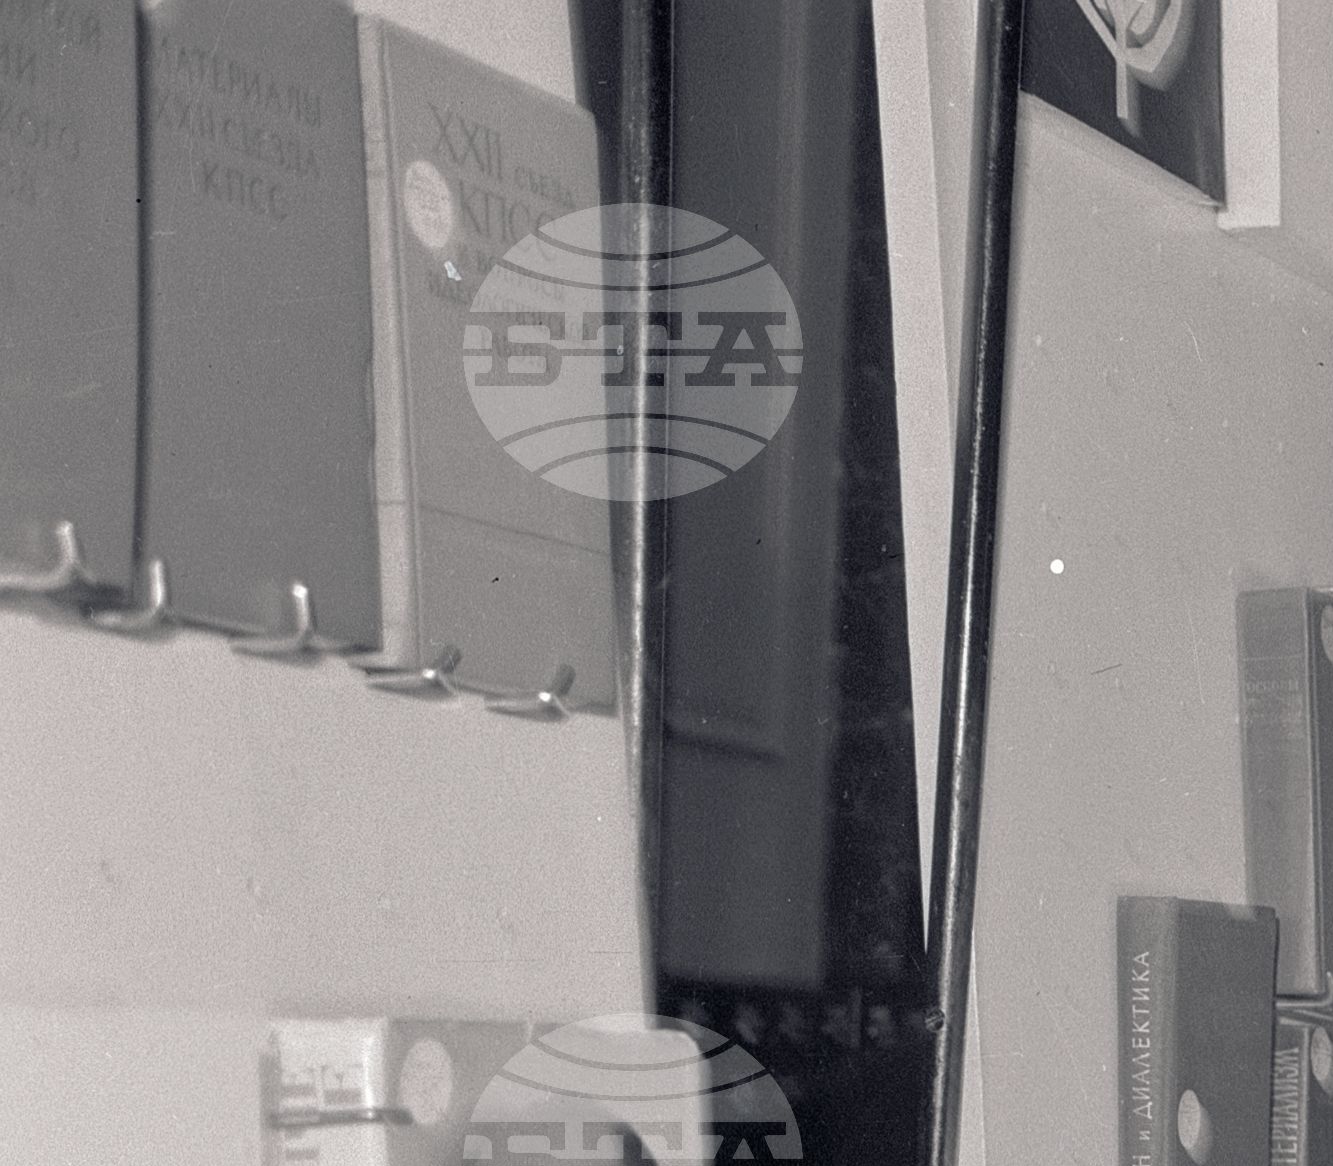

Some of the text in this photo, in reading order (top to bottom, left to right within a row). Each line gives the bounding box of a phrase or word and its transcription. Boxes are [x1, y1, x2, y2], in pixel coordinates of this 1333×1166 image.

[201, 158, 289, 221] КПСС
[1131, 950, 1154, 1121] ДИАЛЕКТИКА
[1137, 1129, 1152, 1142] и
